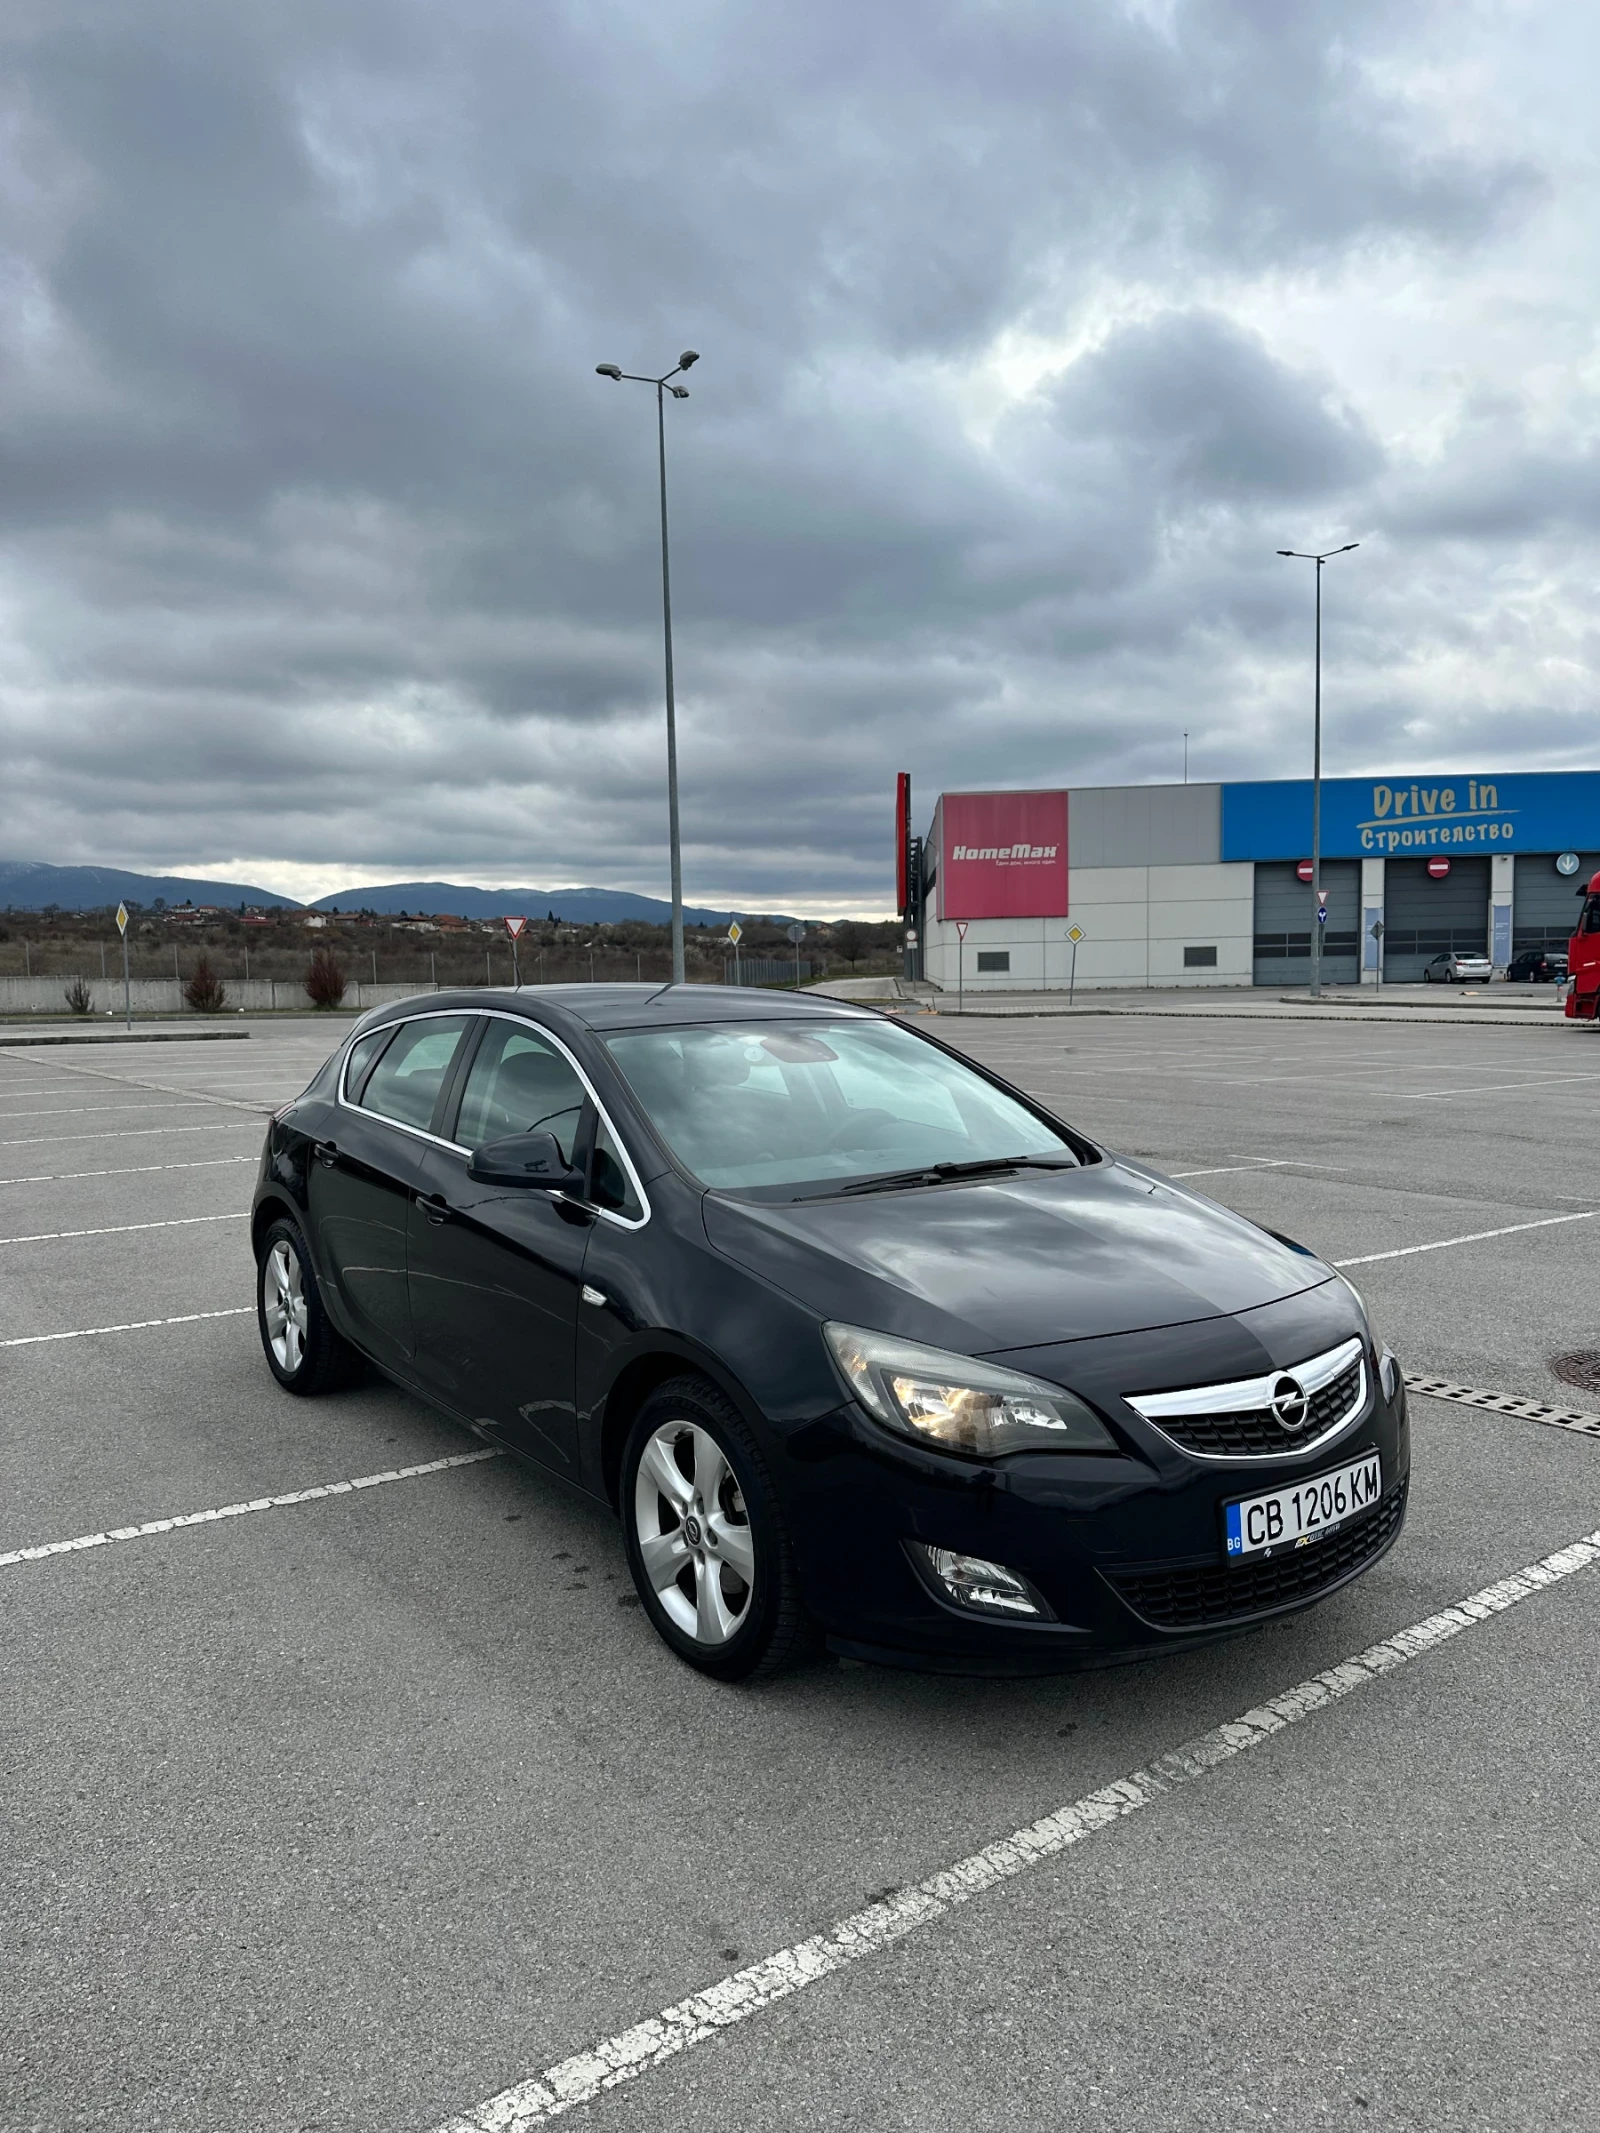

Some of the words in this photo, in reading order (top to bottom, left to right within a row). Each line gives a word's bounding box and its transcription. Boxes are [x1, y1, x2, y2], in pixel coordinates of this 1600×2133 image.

[1373, 784, 1456, 818] Drive
[1469, 780, 1498, 810] in
[952, 844, 1057, 860] HomeMax
[1361, 823, 1514, 852] Строителство
[1247, 1499, 1283, 1545] CB
[1292, 1476, 1346, 1531] 1206
[1350, 1462, 1378, 1509] KM
[1227, 1537, 1241, 1551] BG
